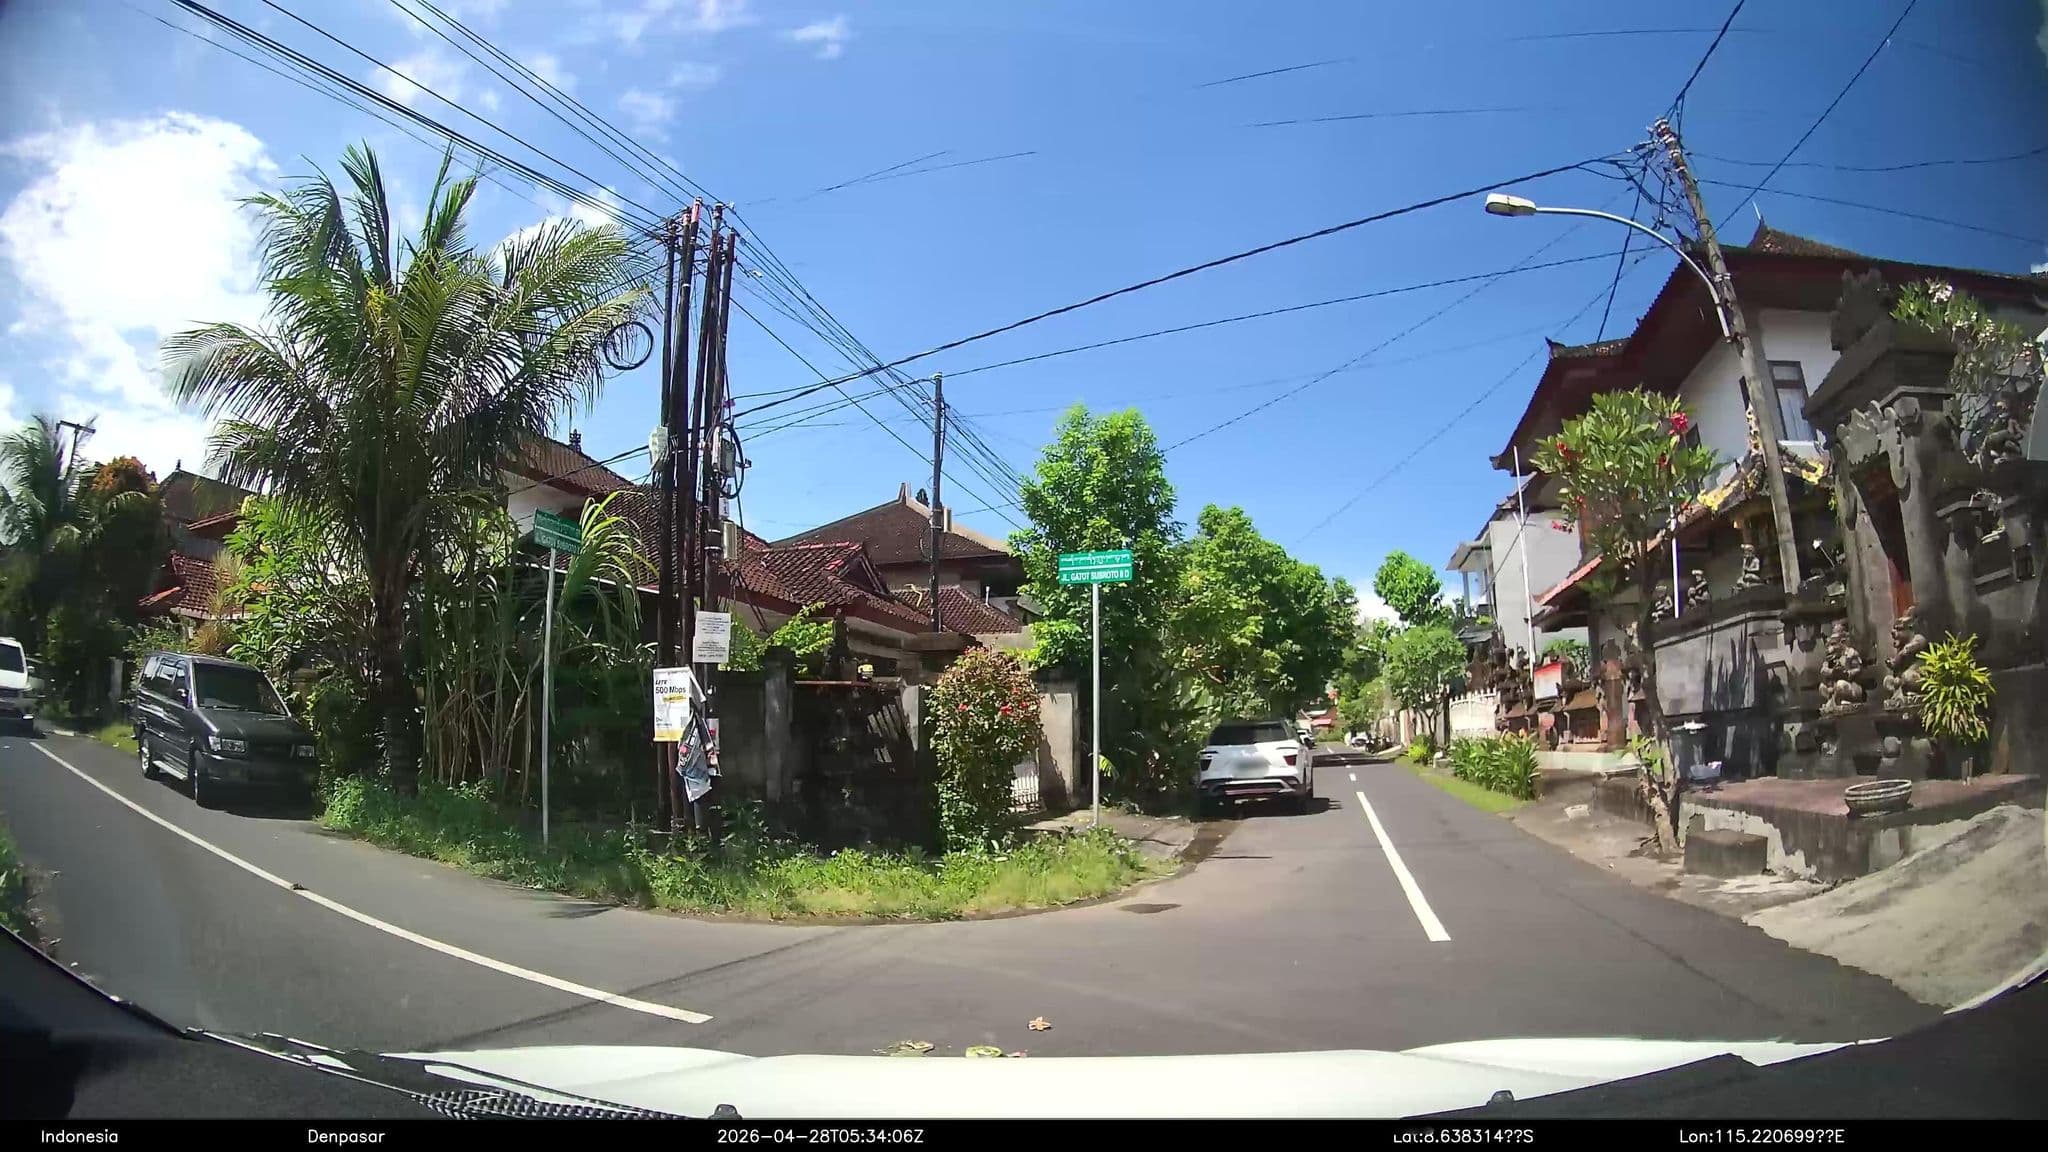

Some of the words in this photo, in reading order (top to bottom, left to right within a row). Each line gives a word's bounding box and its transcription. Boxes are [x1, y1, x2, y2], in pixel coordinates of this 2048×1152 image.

[1071, 573, 1090, 581] GATOT
[655, 686, 668, 694] 500
[669, 686, 686, 694] Mbps
